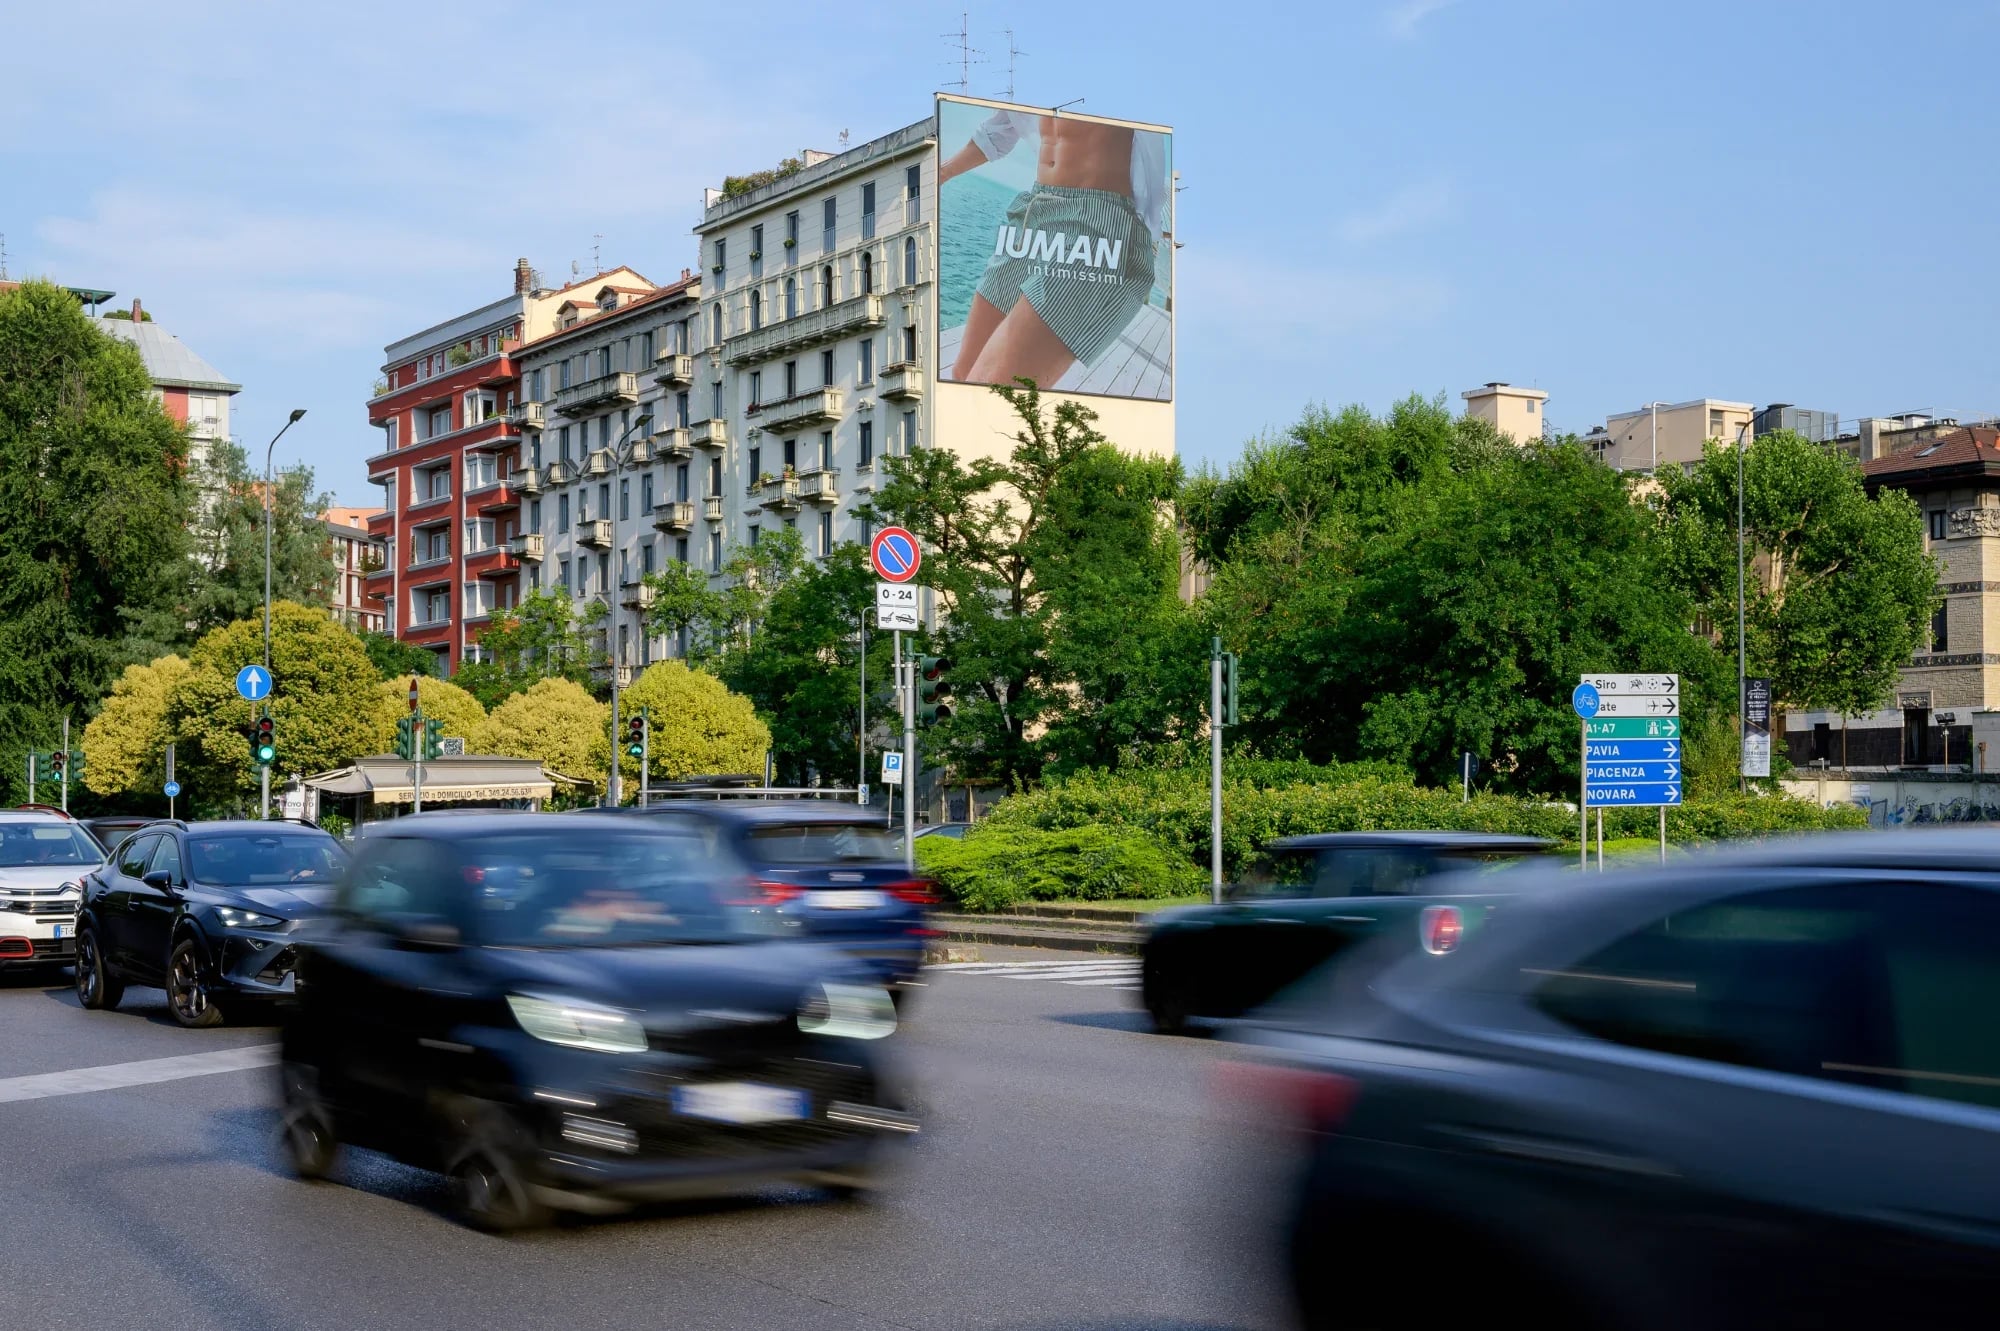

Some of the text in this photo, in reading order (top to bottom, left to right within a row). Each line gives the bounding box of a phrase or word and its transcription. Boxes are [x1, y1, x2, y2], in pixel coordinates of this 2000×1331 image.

[995, 225, 1122, 269] IUMAN
[1028, 264, 1123, 285] intimissimi
[898, 590, 912, 600] 24
[1595, 679, 1617, 689] Siro
[1586, 723, 1616, 733] A1-A7
[1586, 745, 1620, 756] PAVIA
[1586, 767, 1645, 778] PIACENZA
[398, 791, 430, 800] SERVZIO
[1587, 789, 1636, 800] NOVARA
